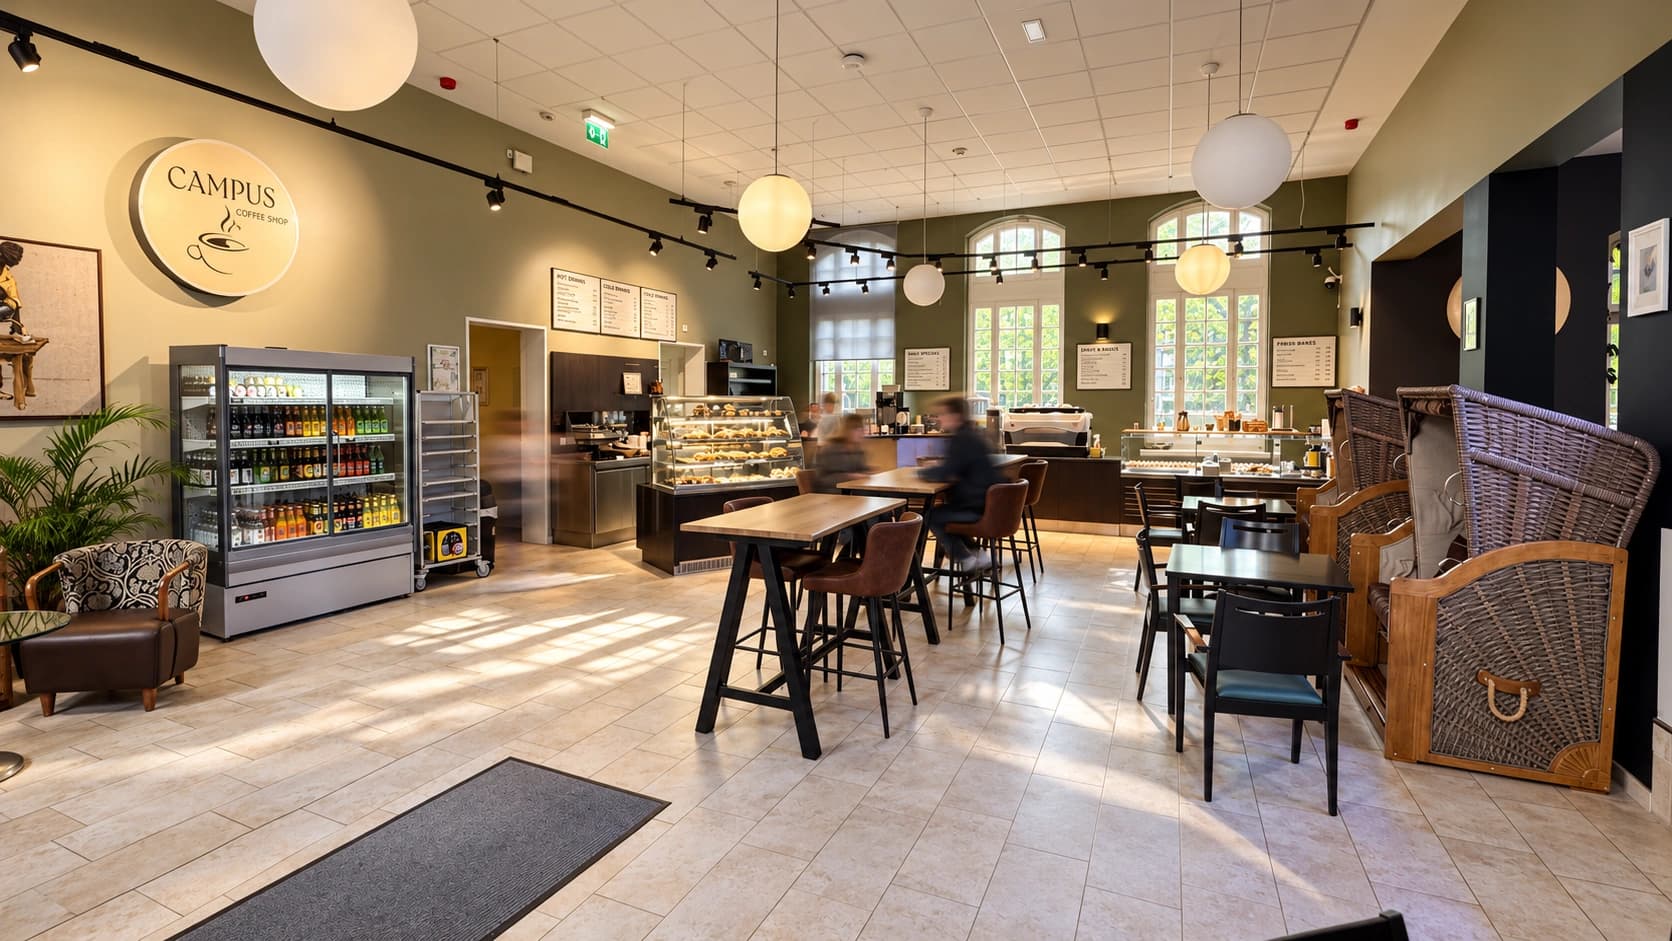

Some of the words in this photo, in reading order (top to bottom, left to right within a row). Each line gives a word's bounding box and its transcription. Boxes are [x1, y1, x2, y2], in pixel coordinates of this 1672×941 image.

[168, 166, 275, 208] CAMPUS
[235, 208, 265, 221] COFFEE
[267, 215, 288, 226] SHOP
